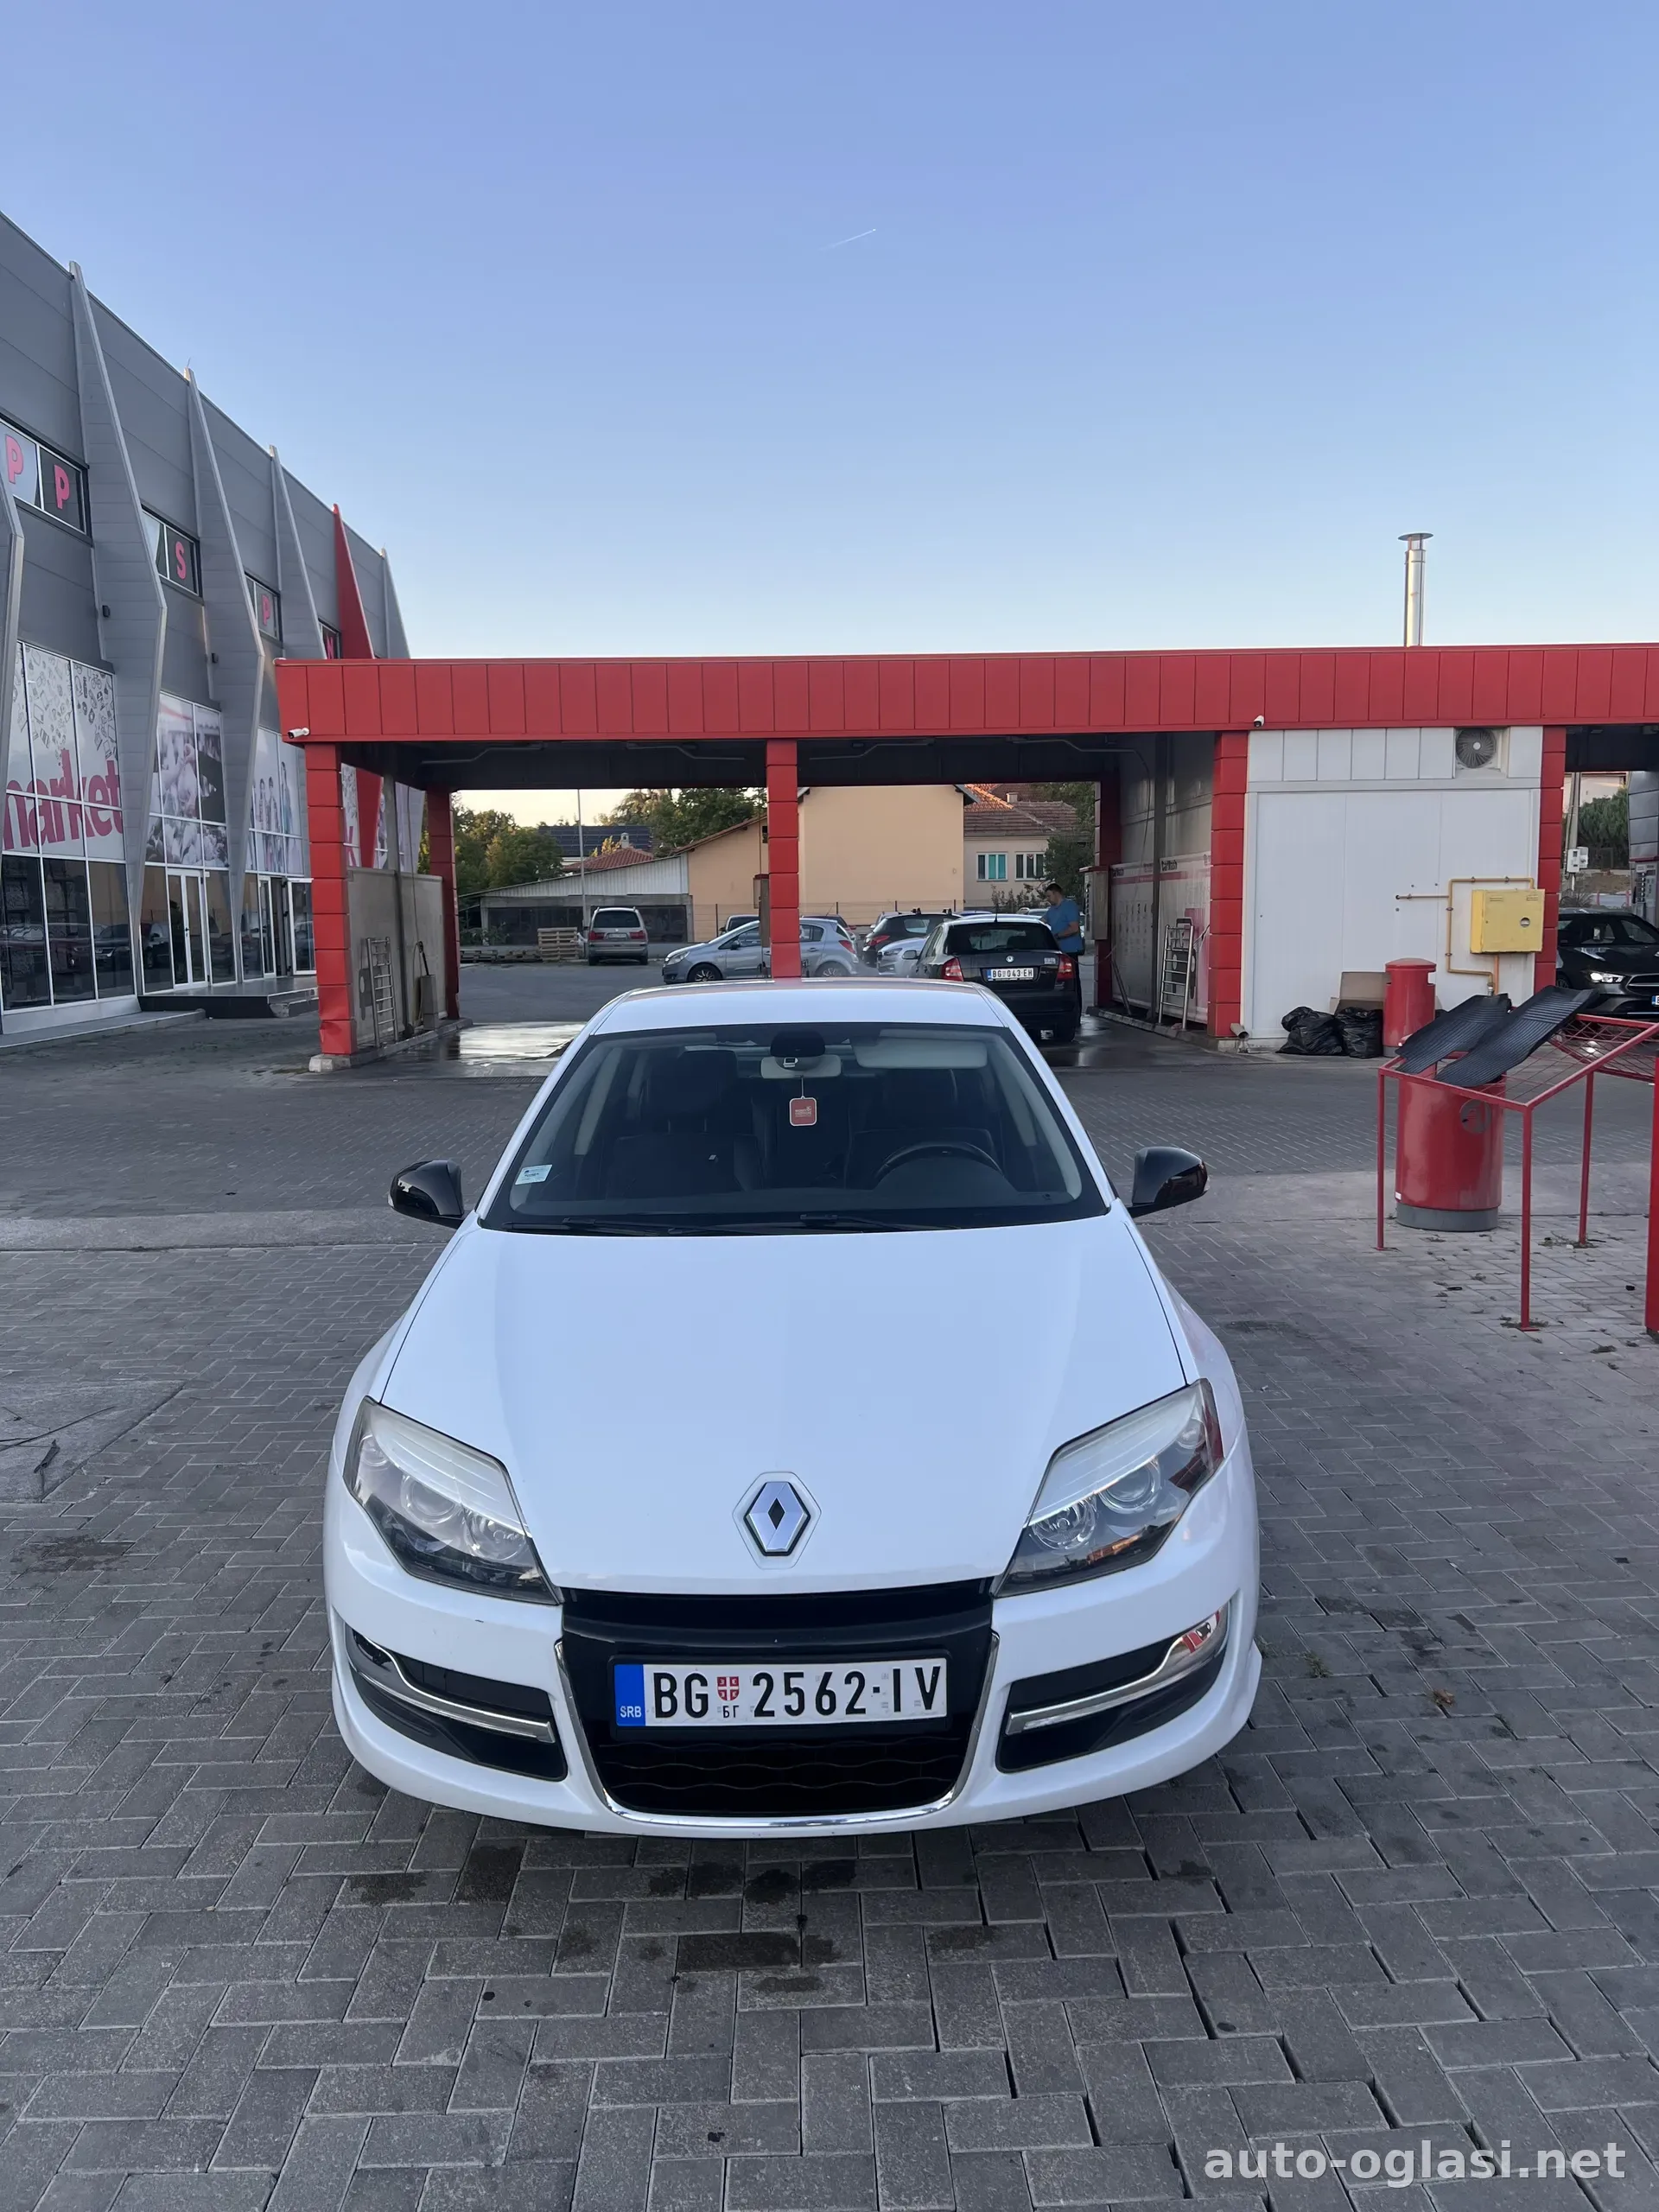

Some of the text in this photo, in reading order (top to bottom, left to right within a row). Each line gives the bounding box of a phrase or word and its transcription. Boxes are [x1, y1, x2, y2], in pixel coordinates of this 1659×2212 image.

[5, 434, 70, 510] P P
[175, 541, 187, 580] S
[262, 594, 271, 626] P
[992, 969, 1002, 978] BG
[652, 1671, 709, 1719] BG
[620, 1705, 642, 1719] SRB
[722, 1705, 740, 1719] БГ
